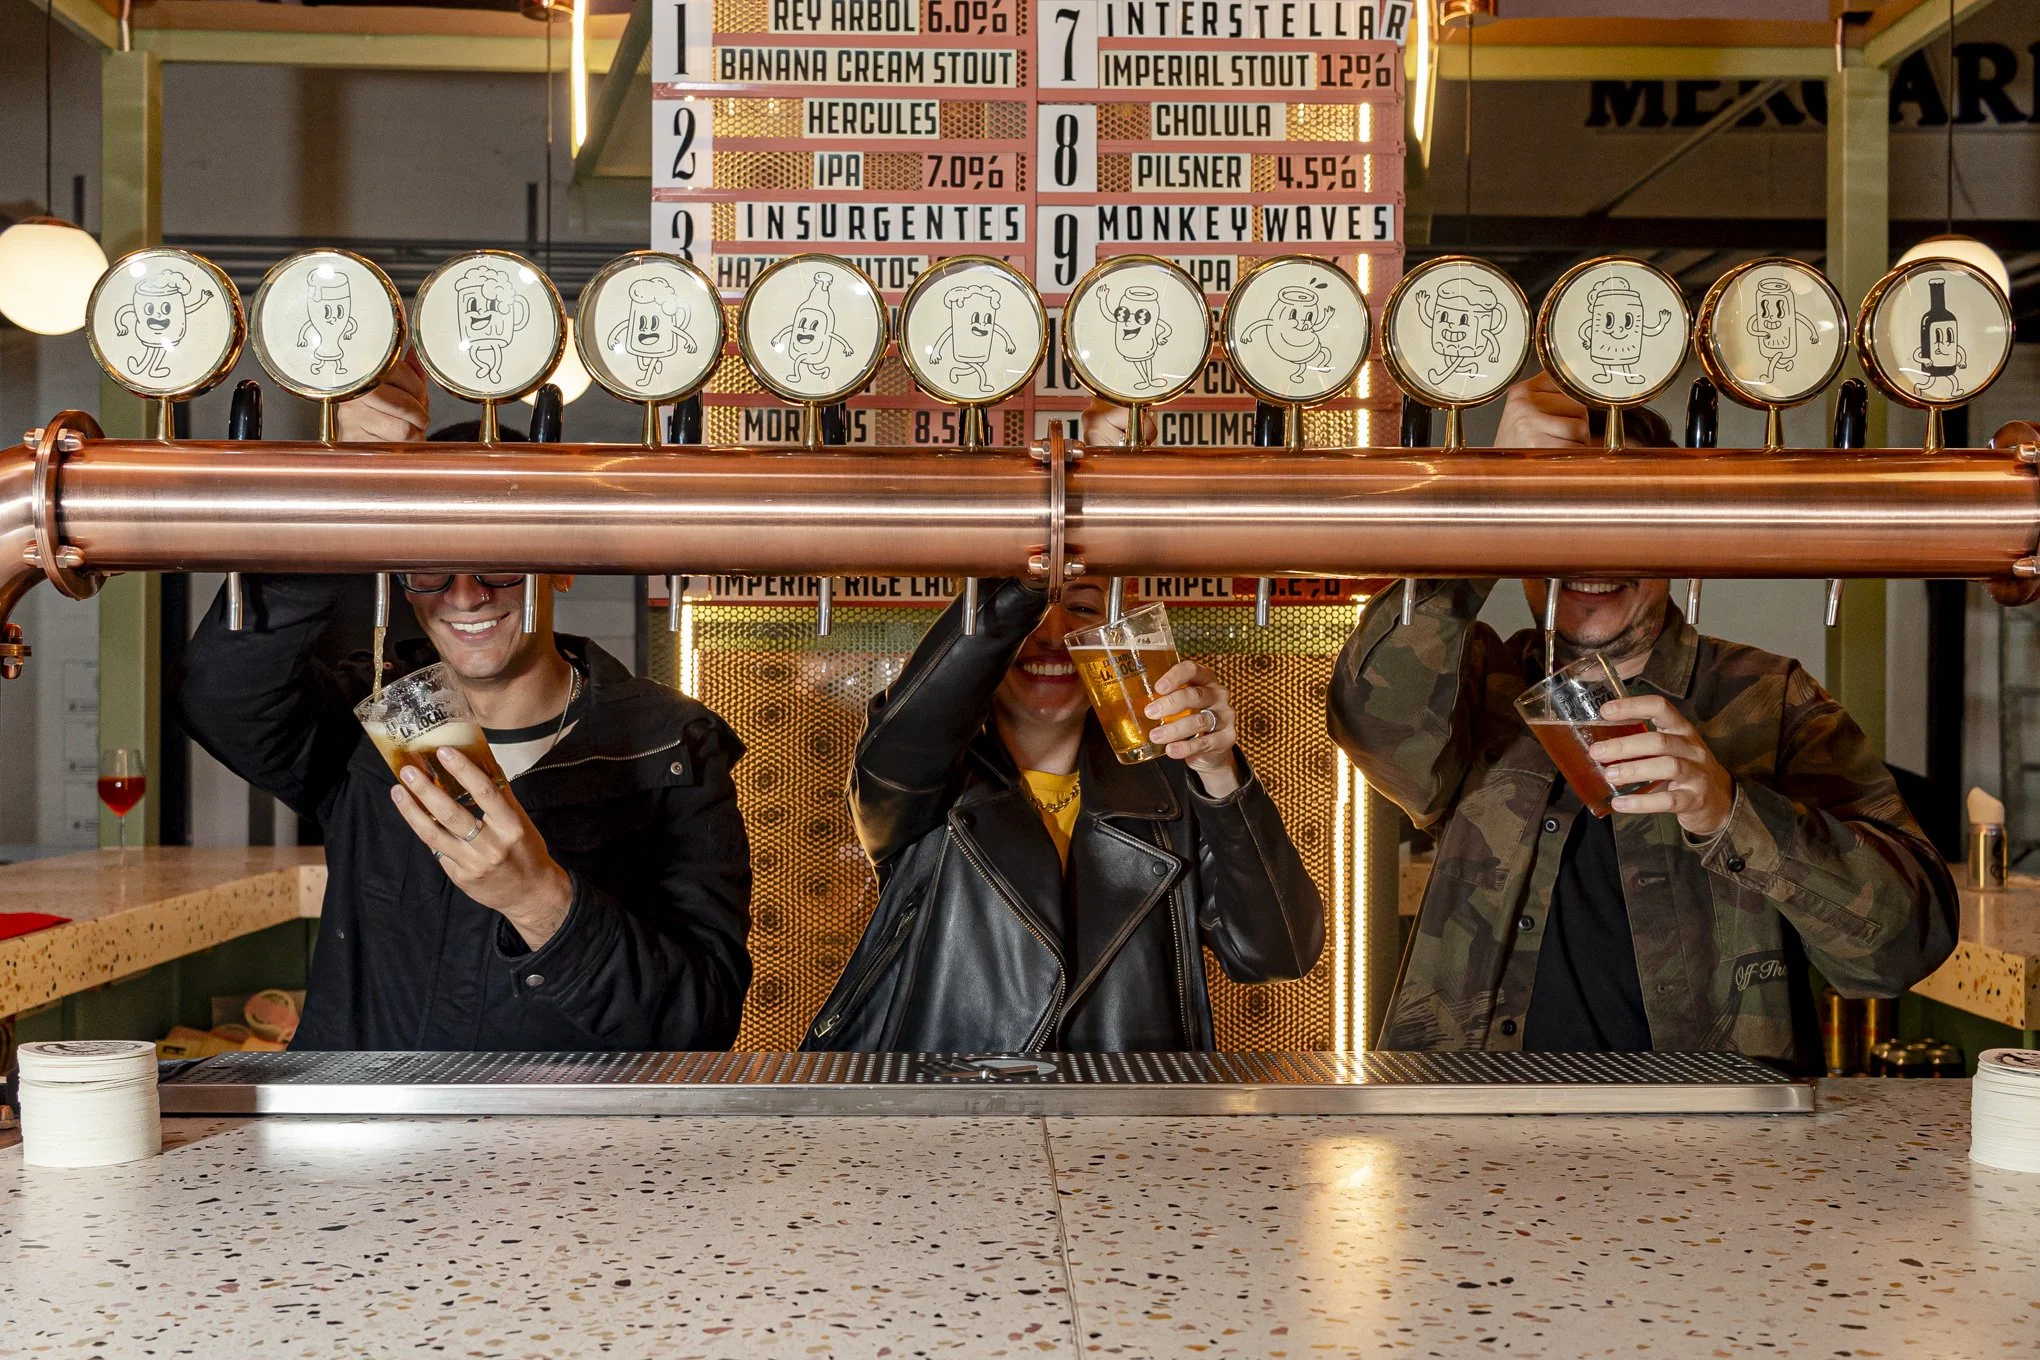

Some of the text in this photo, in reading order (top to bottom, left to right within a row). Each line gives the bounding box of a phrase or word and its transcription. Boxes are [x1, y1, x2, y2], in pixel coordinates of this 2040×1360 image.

[774, 0, 1007, 34] REY ARBOL 6.0%
[1106, 0, 1407, 39] INTERSTELLAR
[673, 3, 689, 75] 1
[1055, 9, 1080, 81] 7
[721, 48, 1012, 85] BANANA CREAM STOUT
[1104, 55, 1309, 87] IMPERIAL STOUT
[1320, 54, 1391, 89] 12%
[808, 101, 936, 135] HERCULES
[1156, 104, 1271, 136] CHOLULA
[673, 107, 696, 180] 2
[1054, 114, 1079, 187] 8
[819, 154, 1004, 190] IPA 7.0%
[1137, 155, 1356, 190] PILSNER 4.5%
[746, 203, 1020, 241] INSURGENTES
[1099, 206, 1387, 241] MONKEY WAVES
[1054, 214, 1079, 286] 9
[916, 411, 993, 444] 8.5
[716, 576, 836, 596] IMPERIA
[416, 709, 450, 731] LOCAL
[1736, 962, 1758, 991] Off
